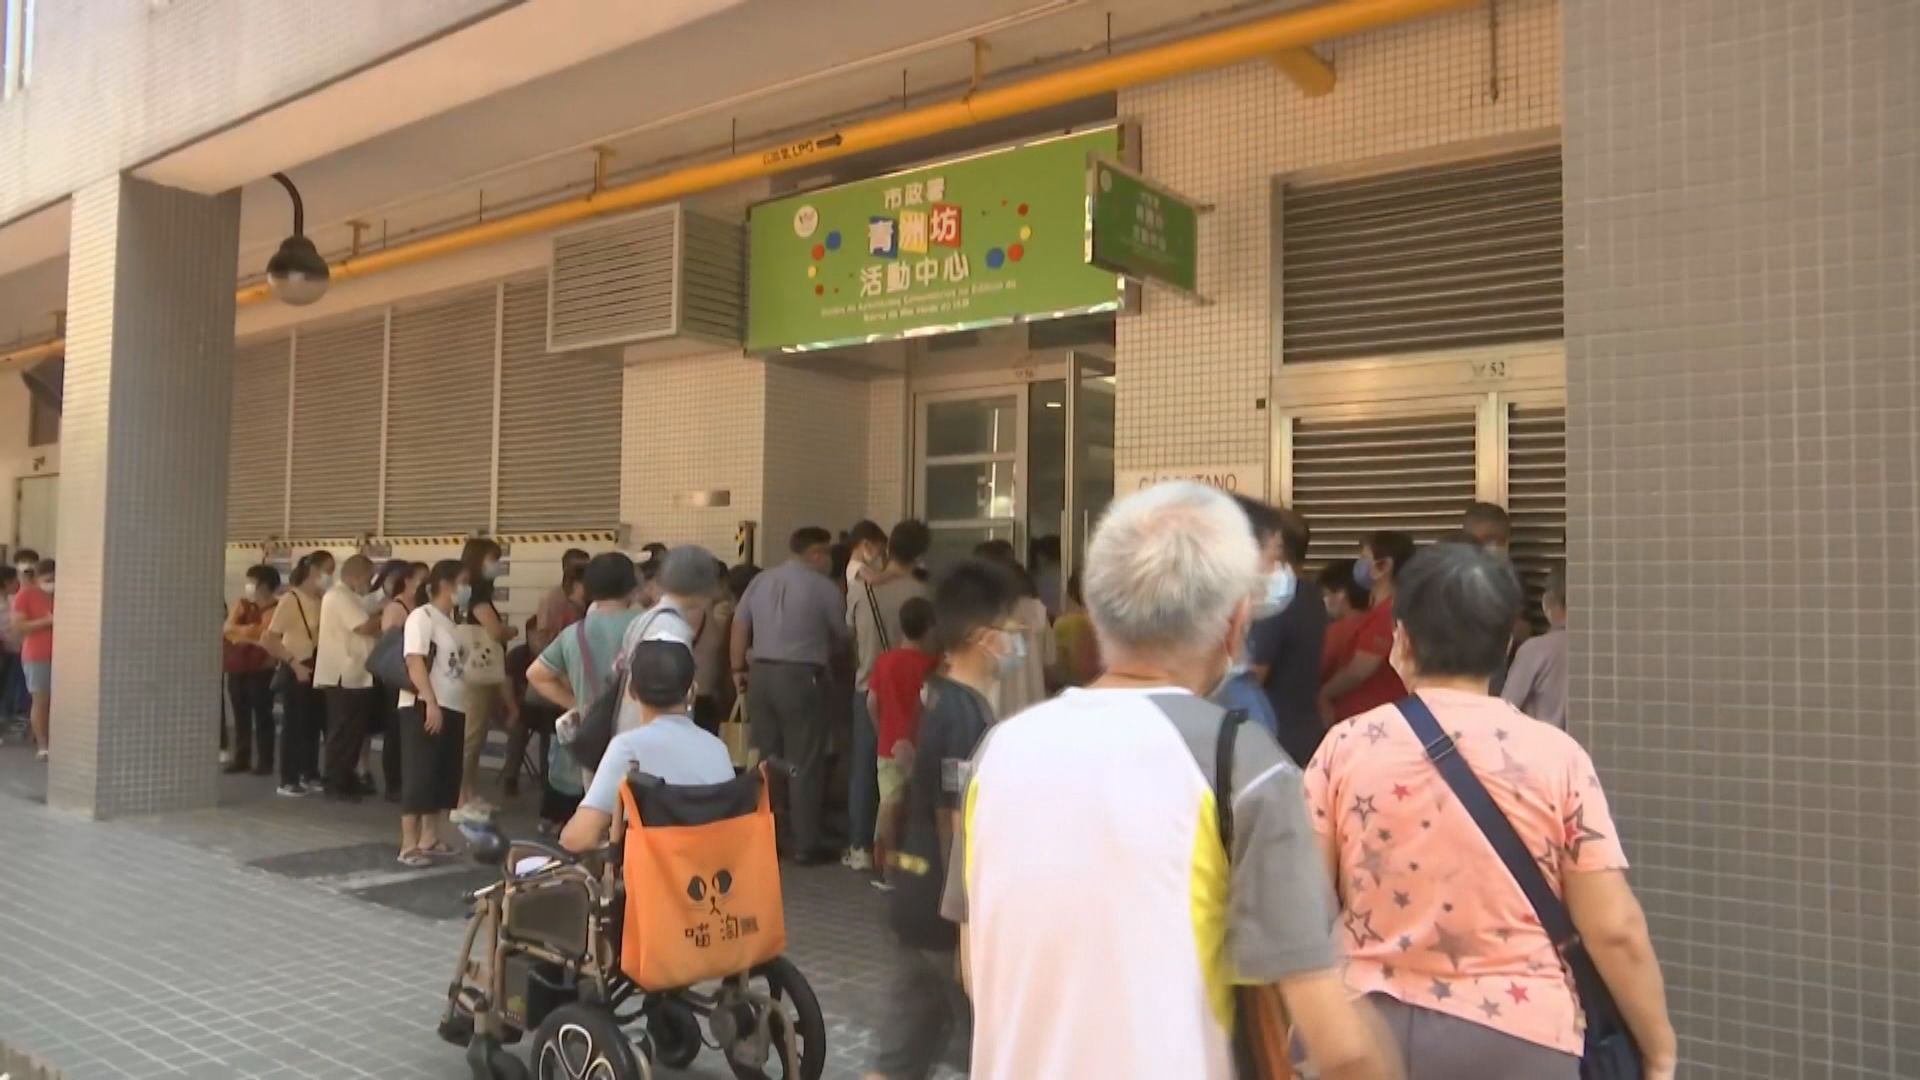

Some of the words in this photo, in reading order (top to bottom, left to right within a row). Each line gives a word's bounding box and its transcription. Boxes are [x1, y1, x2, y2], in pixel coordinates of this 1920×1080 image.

[884, 177, 945, 210] 市政署
[868, 206, 958, 255] 青洲坊
[860, 250, 969, 297] 活動中心
